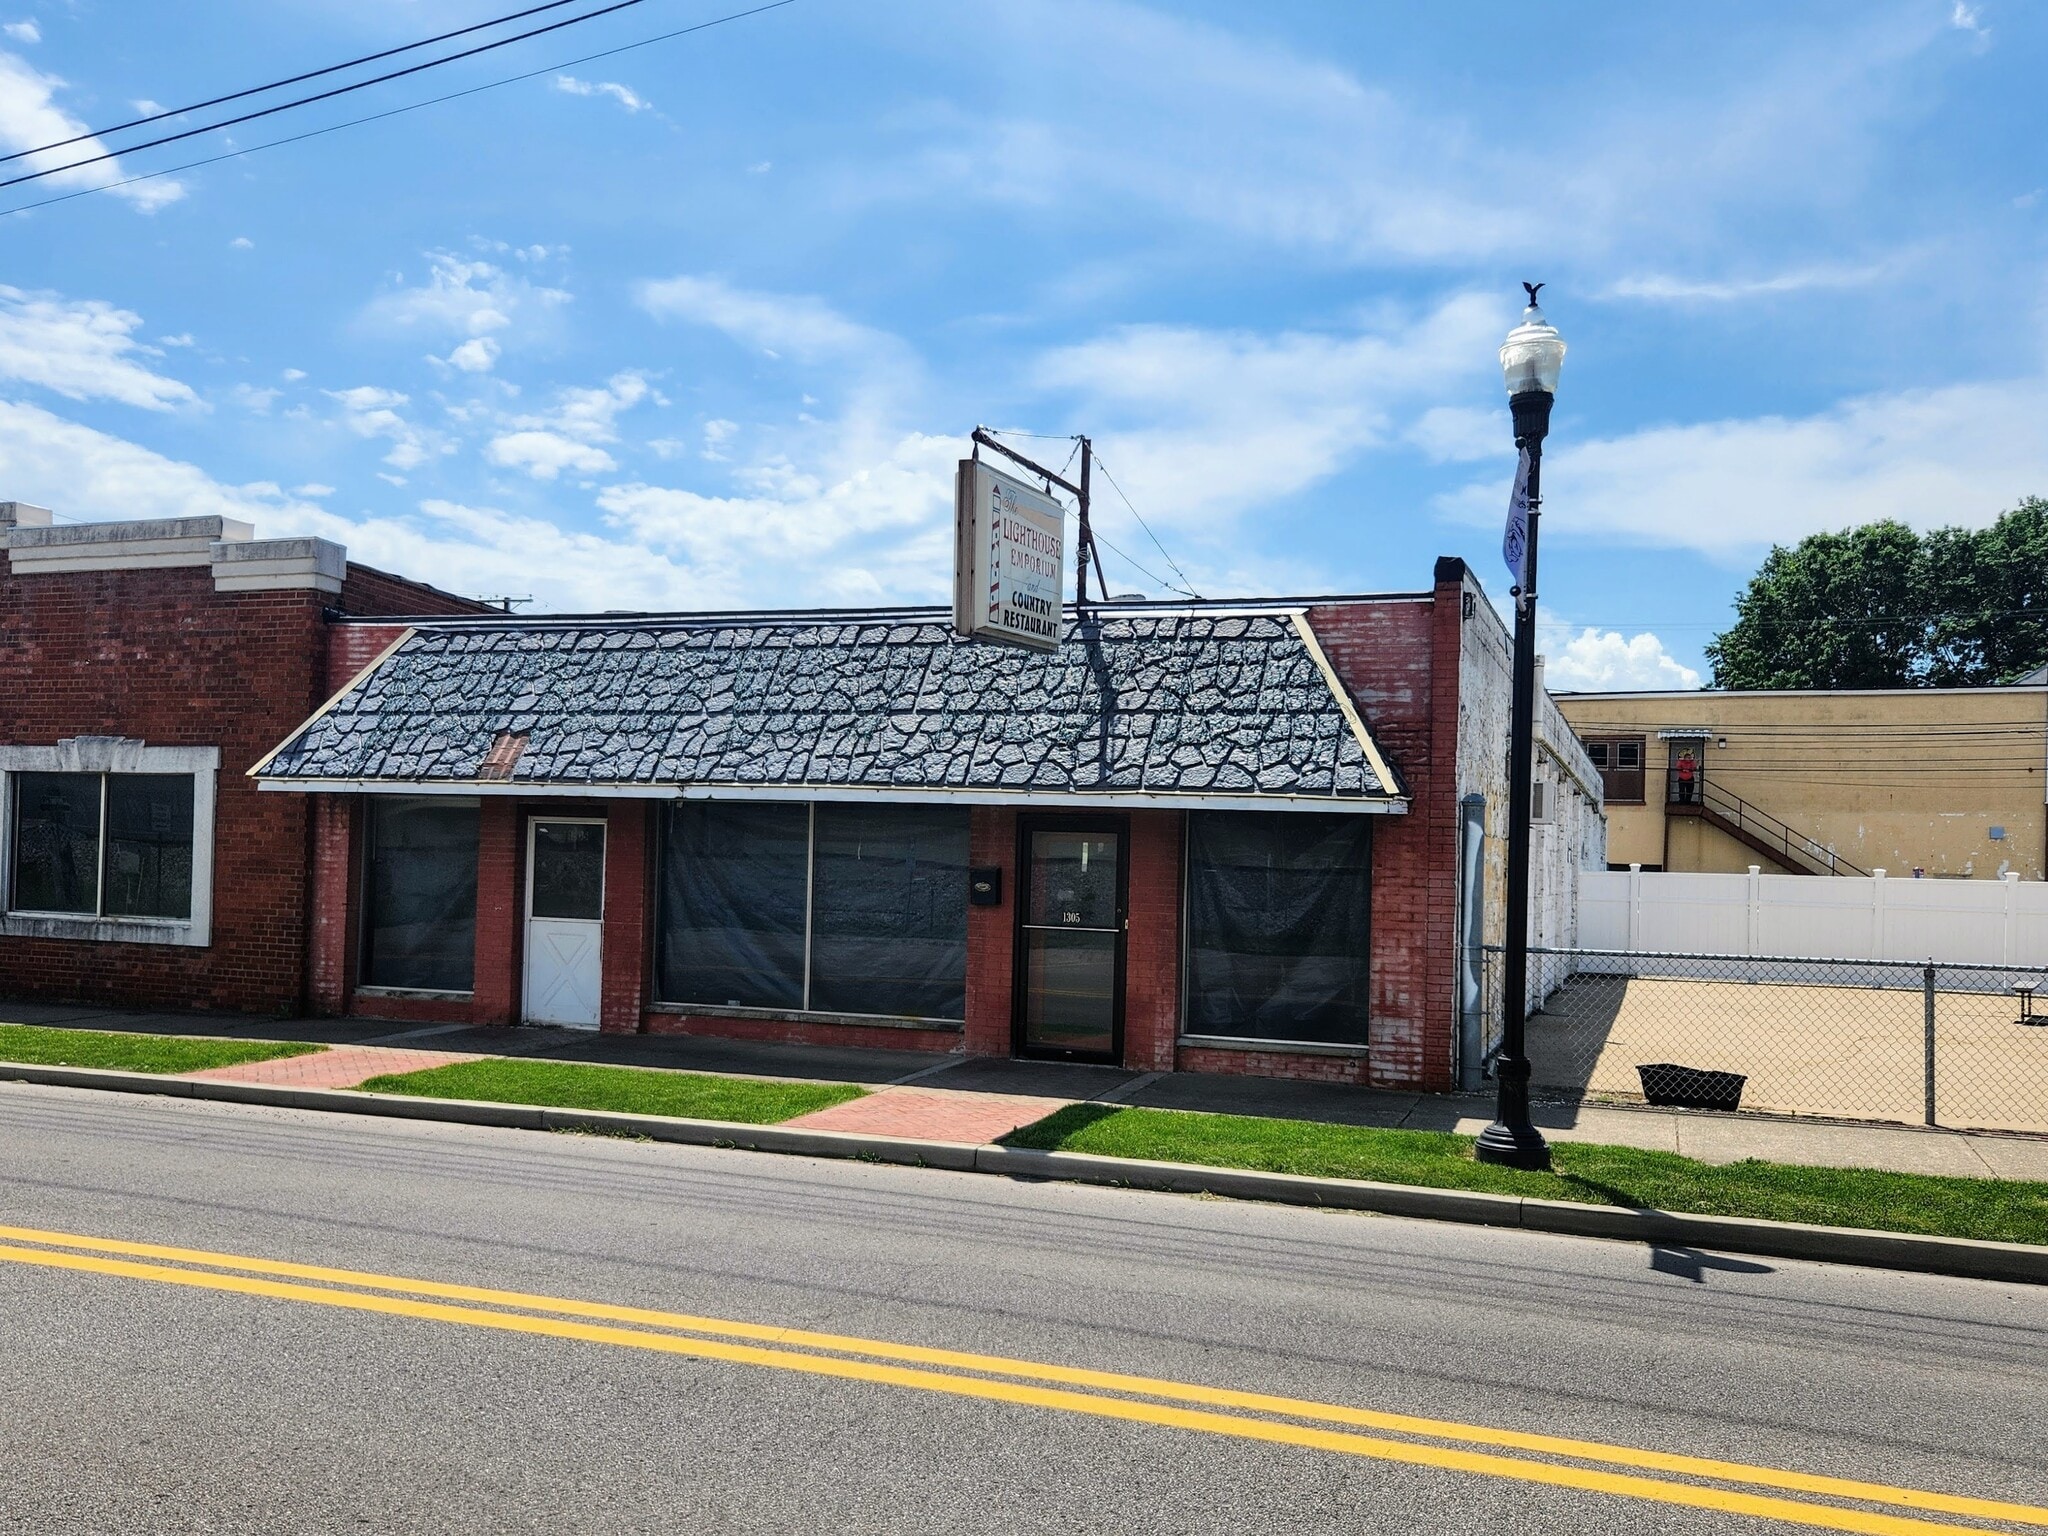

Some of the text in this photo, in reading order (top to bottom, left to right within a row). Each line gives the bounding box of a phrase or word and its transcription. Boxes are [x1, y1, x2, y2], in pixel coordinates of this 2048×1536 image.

[1003, 518, 1061, 560] LIGHTHOUSE
[1011, 548, 1057, 579] EMPORIUM
[1027, 579, 1041, 593] and
[1012, 590, 1052, 616] COUNTRY
[1003, 609, 1058, 638] RESTAURANT
[1063, 911, 1081, 923] 1305
